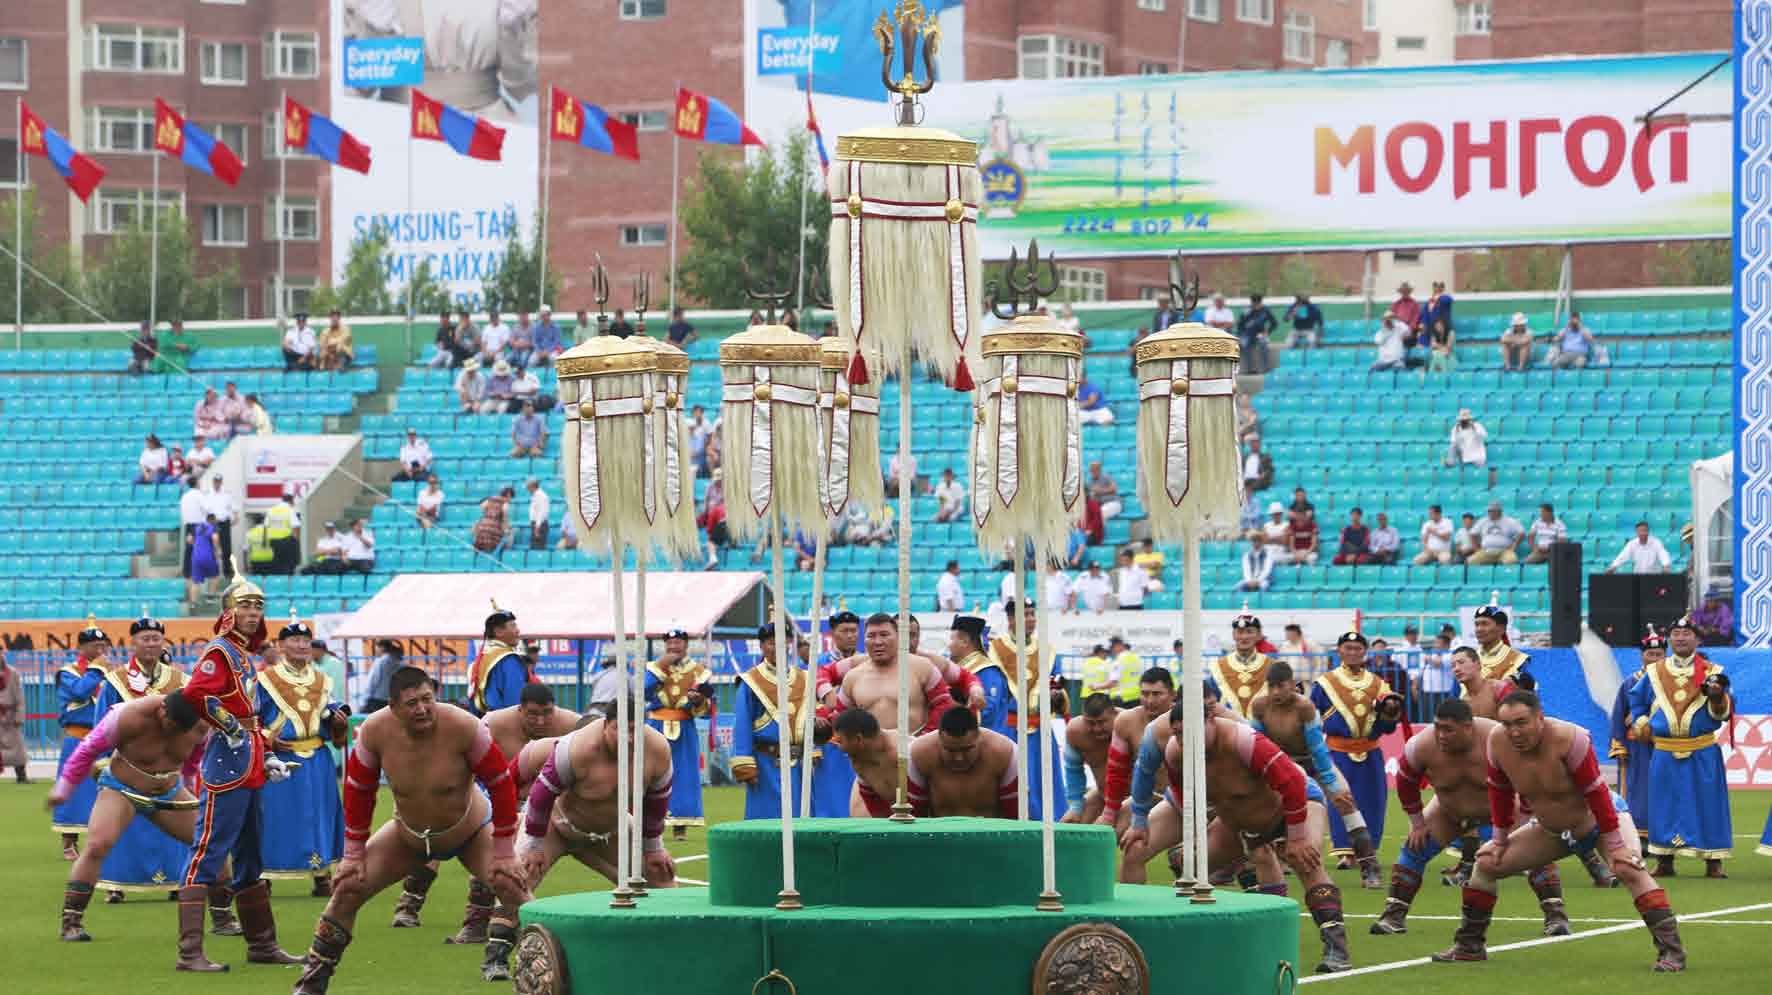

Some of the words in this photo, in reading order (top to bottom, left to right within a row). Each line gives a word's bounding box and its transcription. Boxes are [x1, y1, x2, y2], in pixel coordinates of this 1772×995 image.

[347, 46, 421, 65] Everyday
[347, 63, 398, 81] better
[1314, 113, 1689, 201] МОНГОЛ
